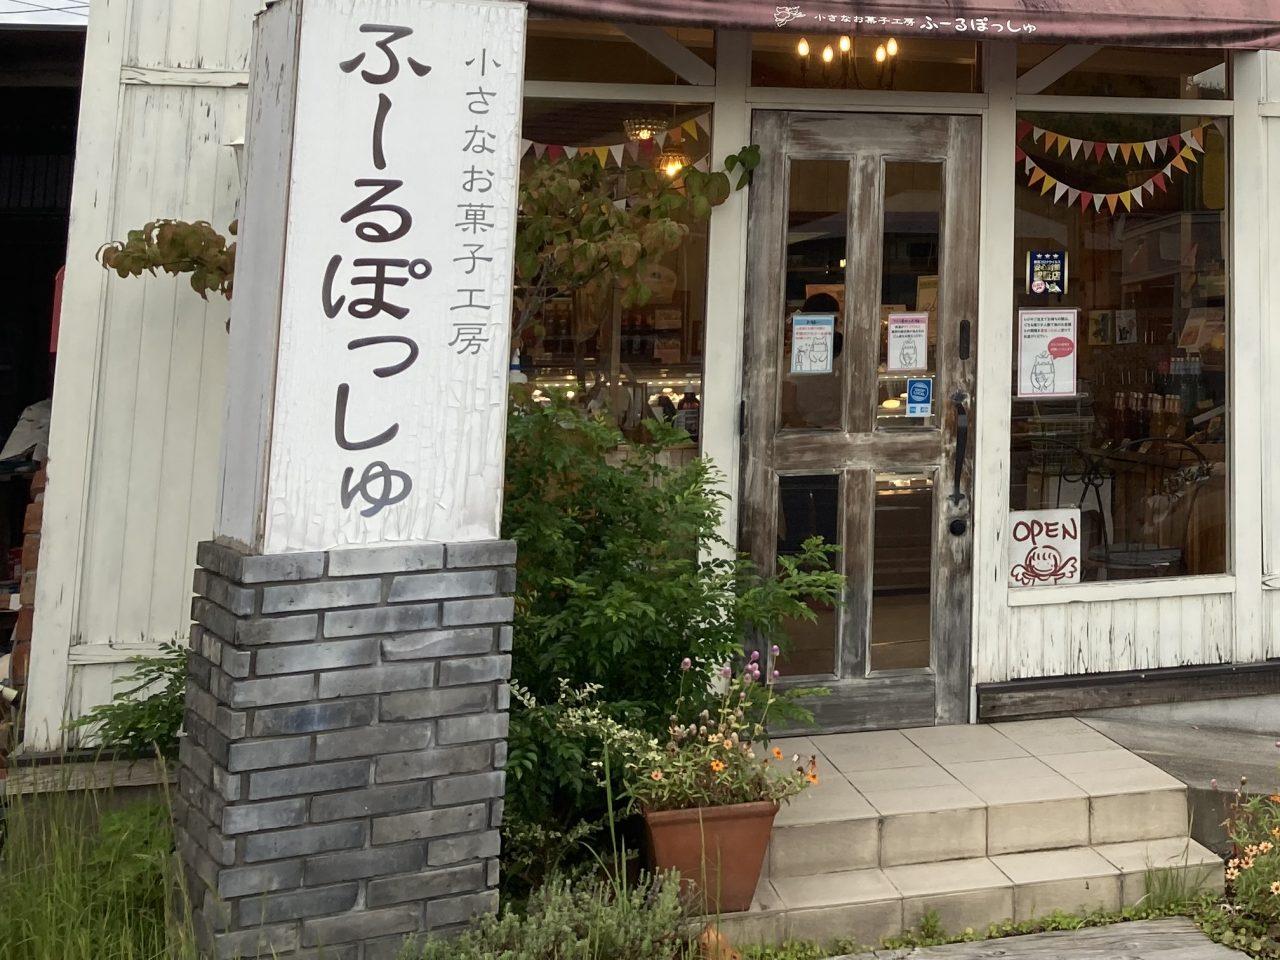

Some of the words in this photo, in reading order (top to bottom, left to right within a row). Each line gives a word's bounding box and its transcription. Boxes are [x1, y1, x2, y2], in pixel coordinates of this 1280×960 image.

[813, 13, 916, 27] 小さなお菓子工房
[919, 16, 1037, 34] ふーるぽっしゅ
[322, 23, 432, 518] ふーるぽっしゅ
[448, 47, 502, 356] 小さなお菓子工房
[1012, 517, 1078, 545] OPEN
